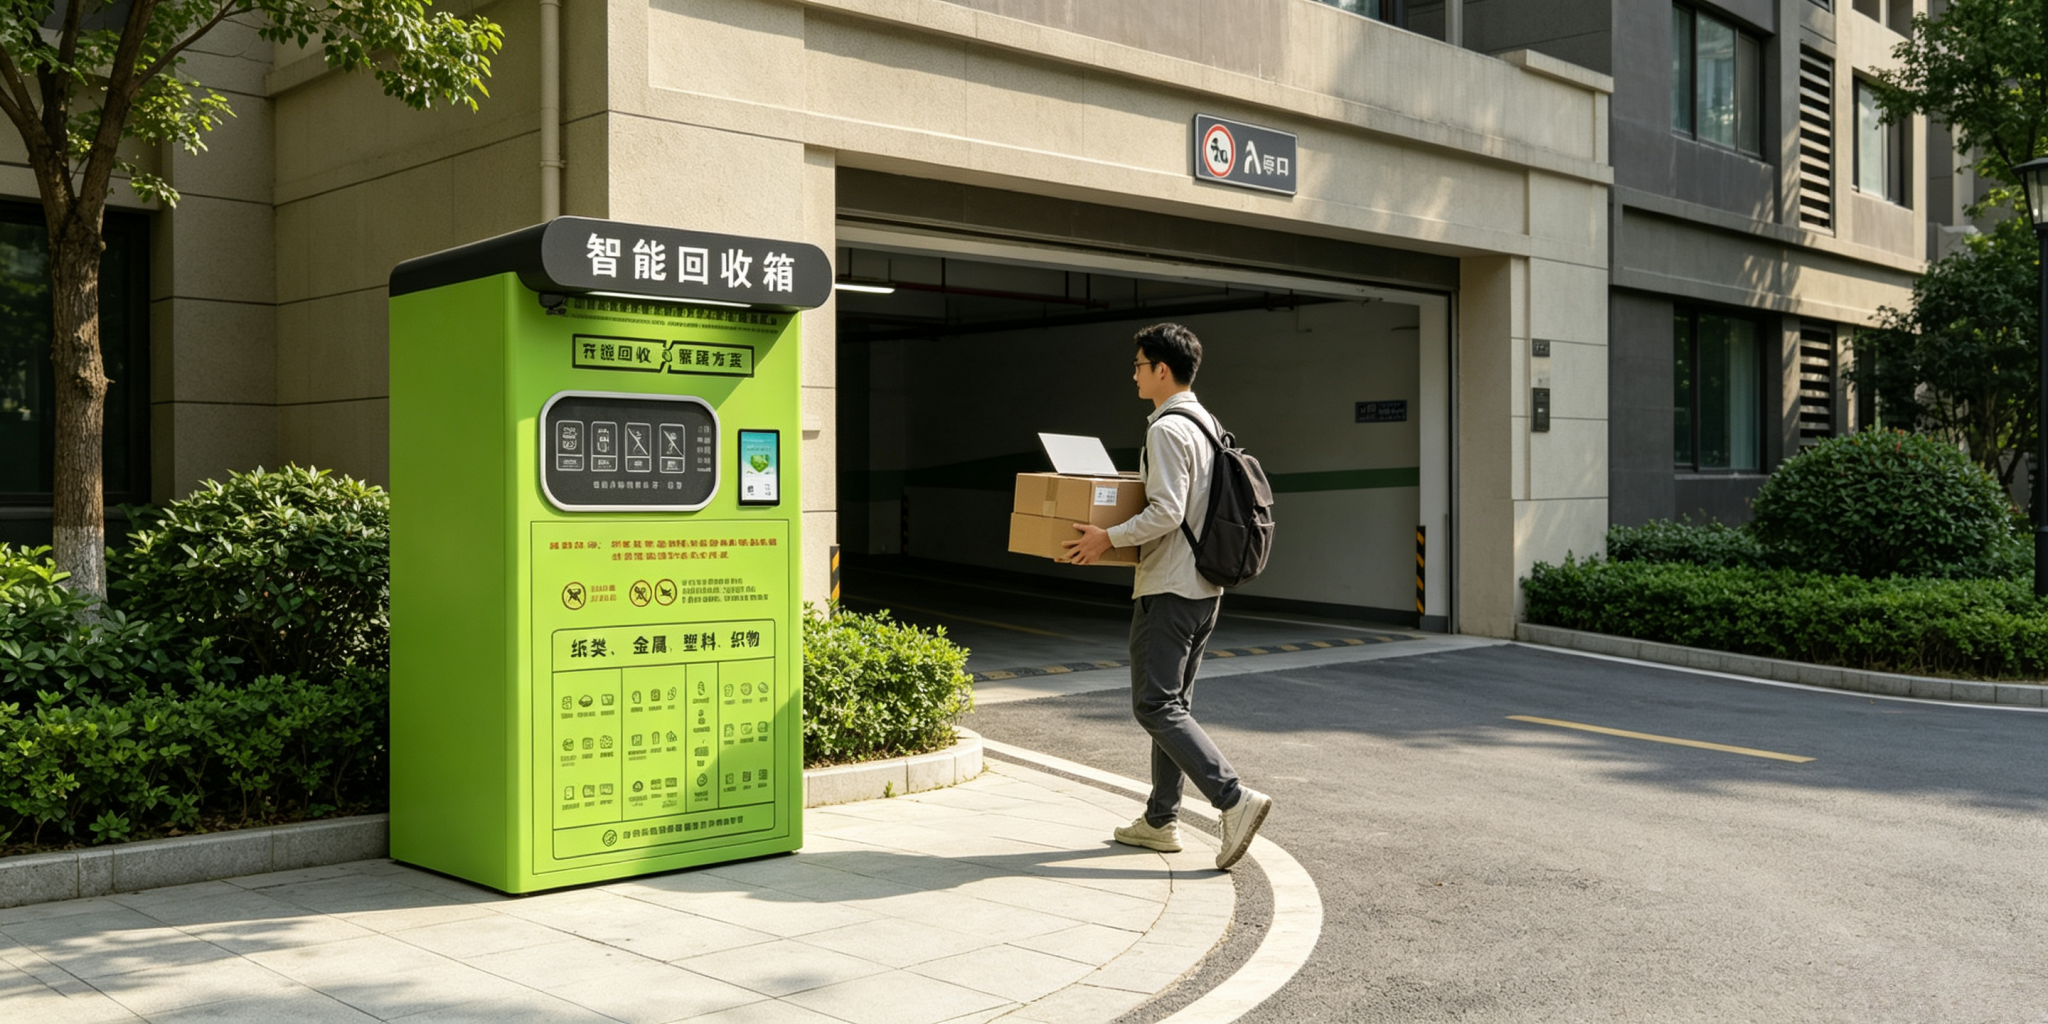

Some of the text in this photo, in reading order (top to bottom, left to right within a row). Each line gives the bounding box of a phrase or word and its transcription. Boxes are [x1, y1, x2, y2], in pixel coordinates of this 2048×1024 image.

[586, 233, 795, 293] 智能回收箱
